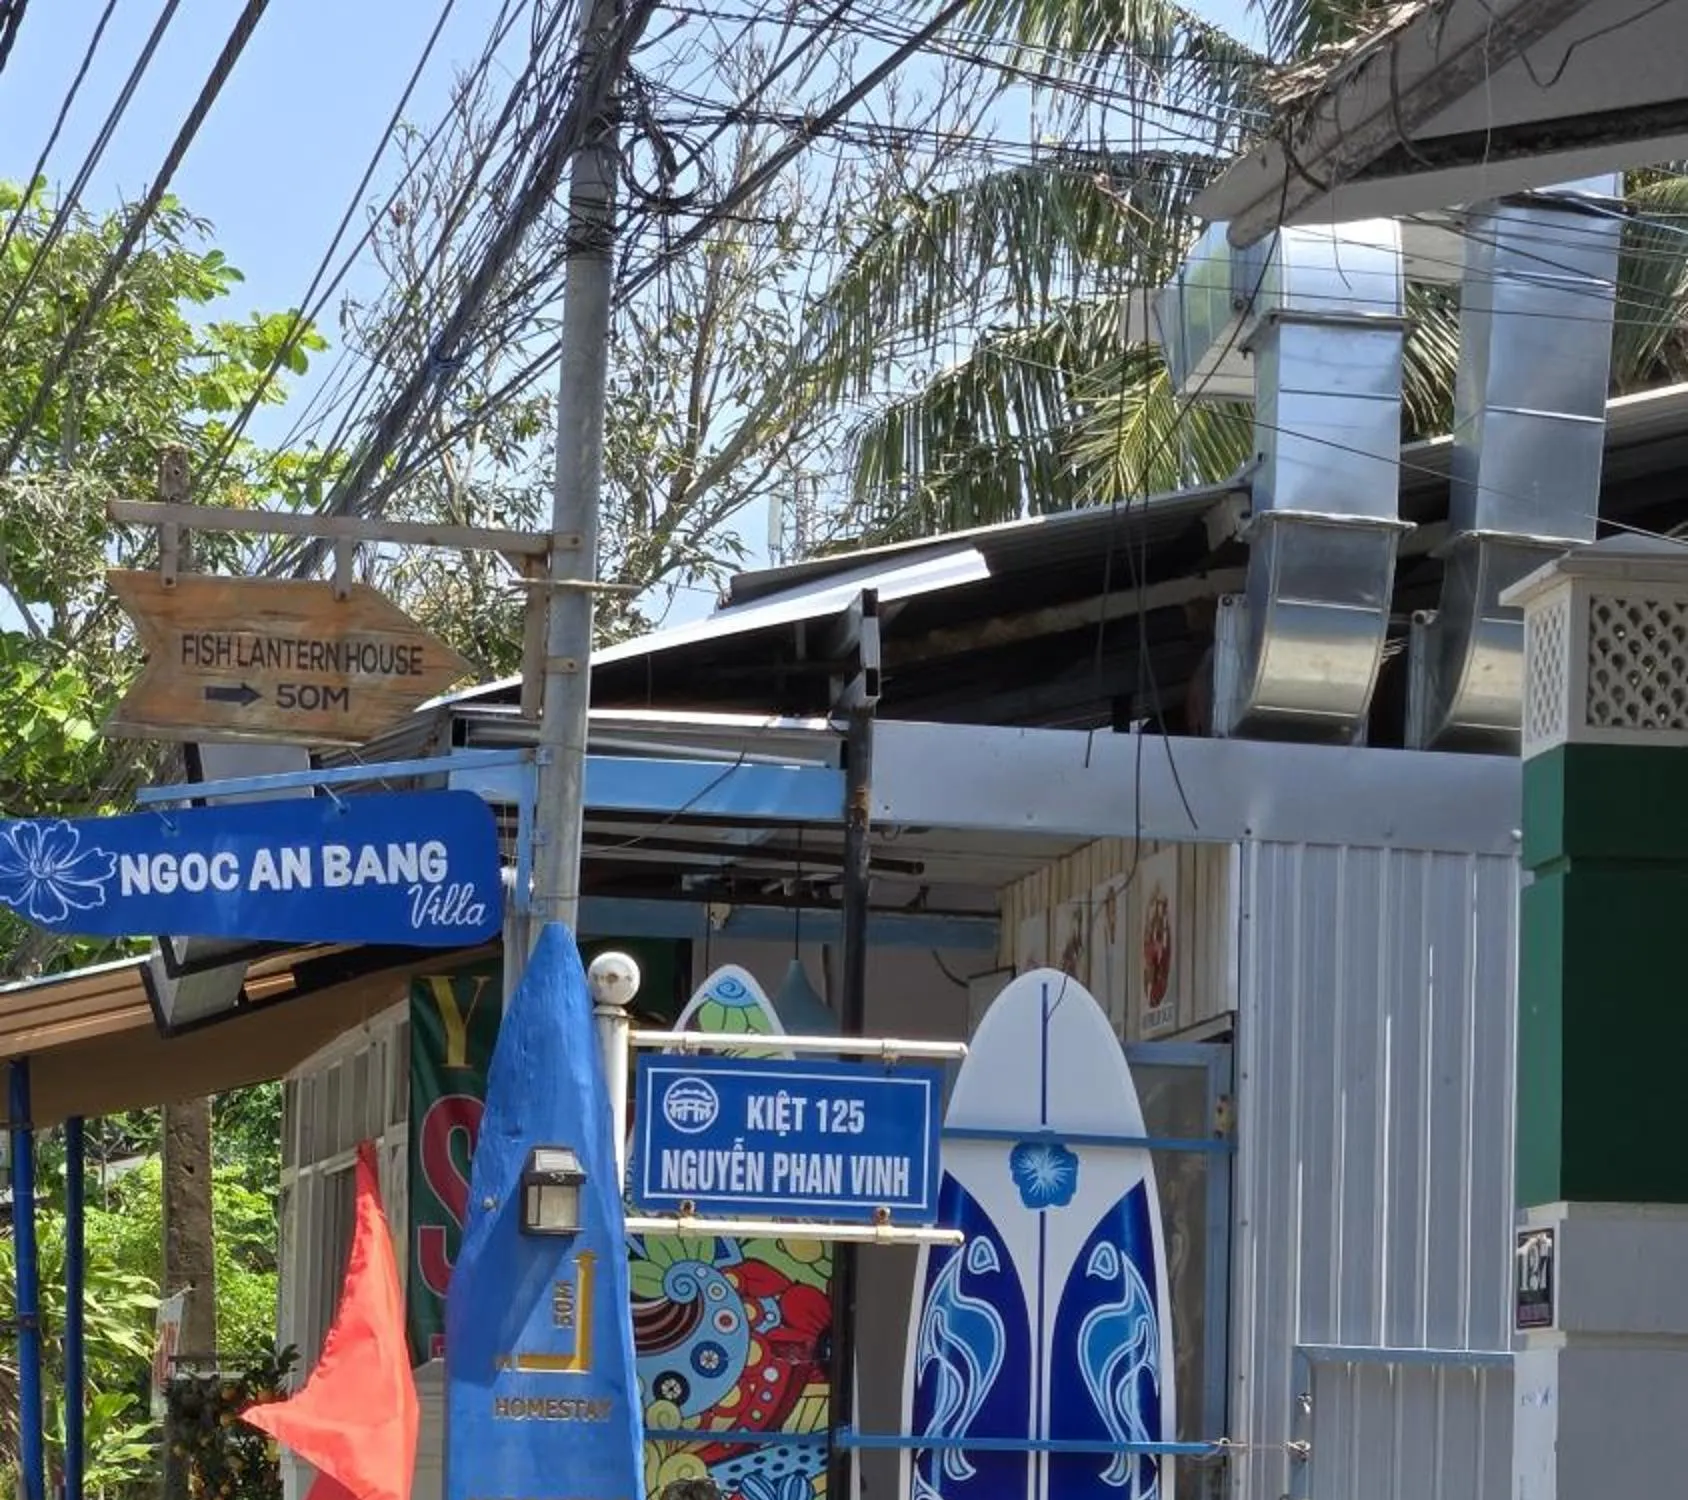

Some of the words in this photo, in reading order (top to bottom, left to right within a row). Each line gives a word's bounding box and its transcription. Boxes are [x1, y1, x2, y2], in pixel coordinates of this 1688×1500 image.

[181, 634, 232, 668] FISH
[236, 638, 340, 672] LANTERN
[344, 643, 424, 676] HOUSE
[275, 683, 350, 712] 50M
[120, 851, 240, 896] NGOC
[249, 848, 313, 892] AN
[322, 841, 448, 887] BANG
[408, 883, 486, 928] Villa
[747, 1090, 807, 1136] KIỆT
[816, 1100, 865, 1134] 125
[661, 1138, 764, 1193] NGUYỄN
[772, 1151, 843, 1195] PHAN
[851, 1156, 910, 1197] VINH
[494, 1398, 611, 1420] HOMESTAY
